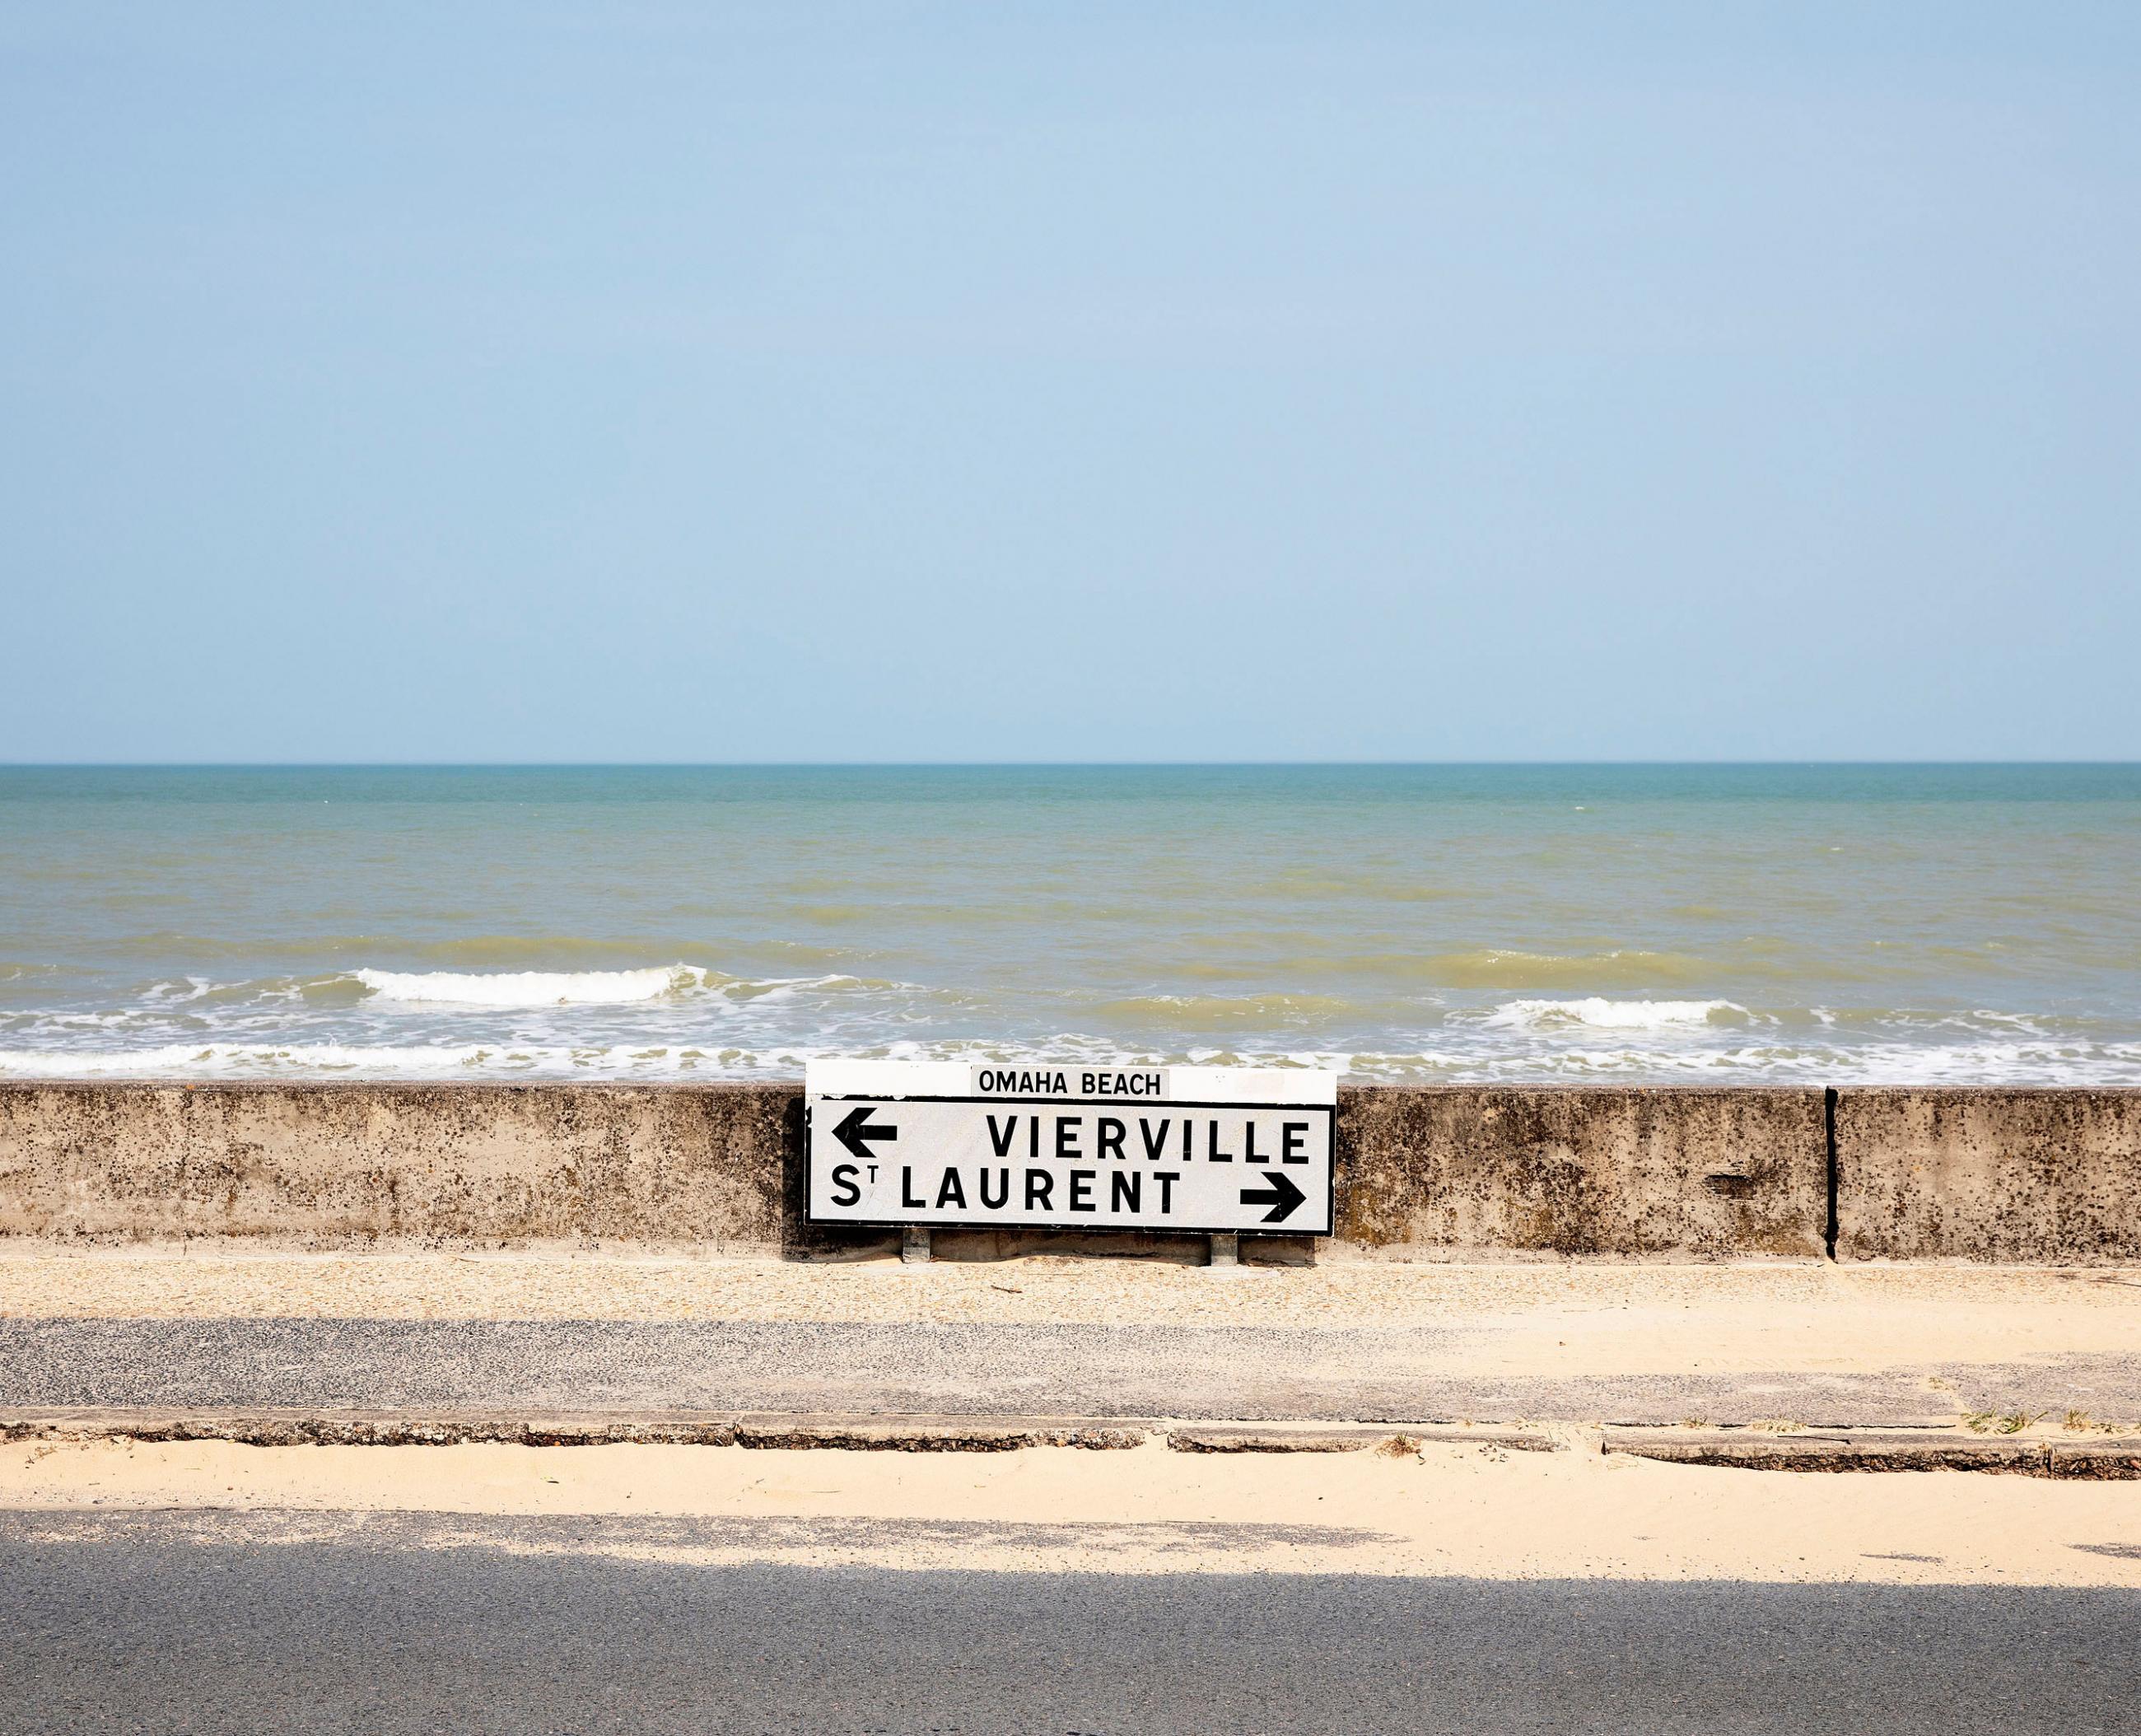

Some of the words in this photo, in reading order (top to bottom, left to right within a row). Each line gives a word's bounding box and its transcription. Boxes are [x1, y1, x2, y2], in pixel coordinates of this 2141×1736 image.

[979, 1070, 1068, 1094] OMAHA
[1081, 1072, 1161, 1095] BEACH
[986, 1114, 1309, 1164] VIERVILLE
[902, 1165, 1180, 1214] LAURENT
